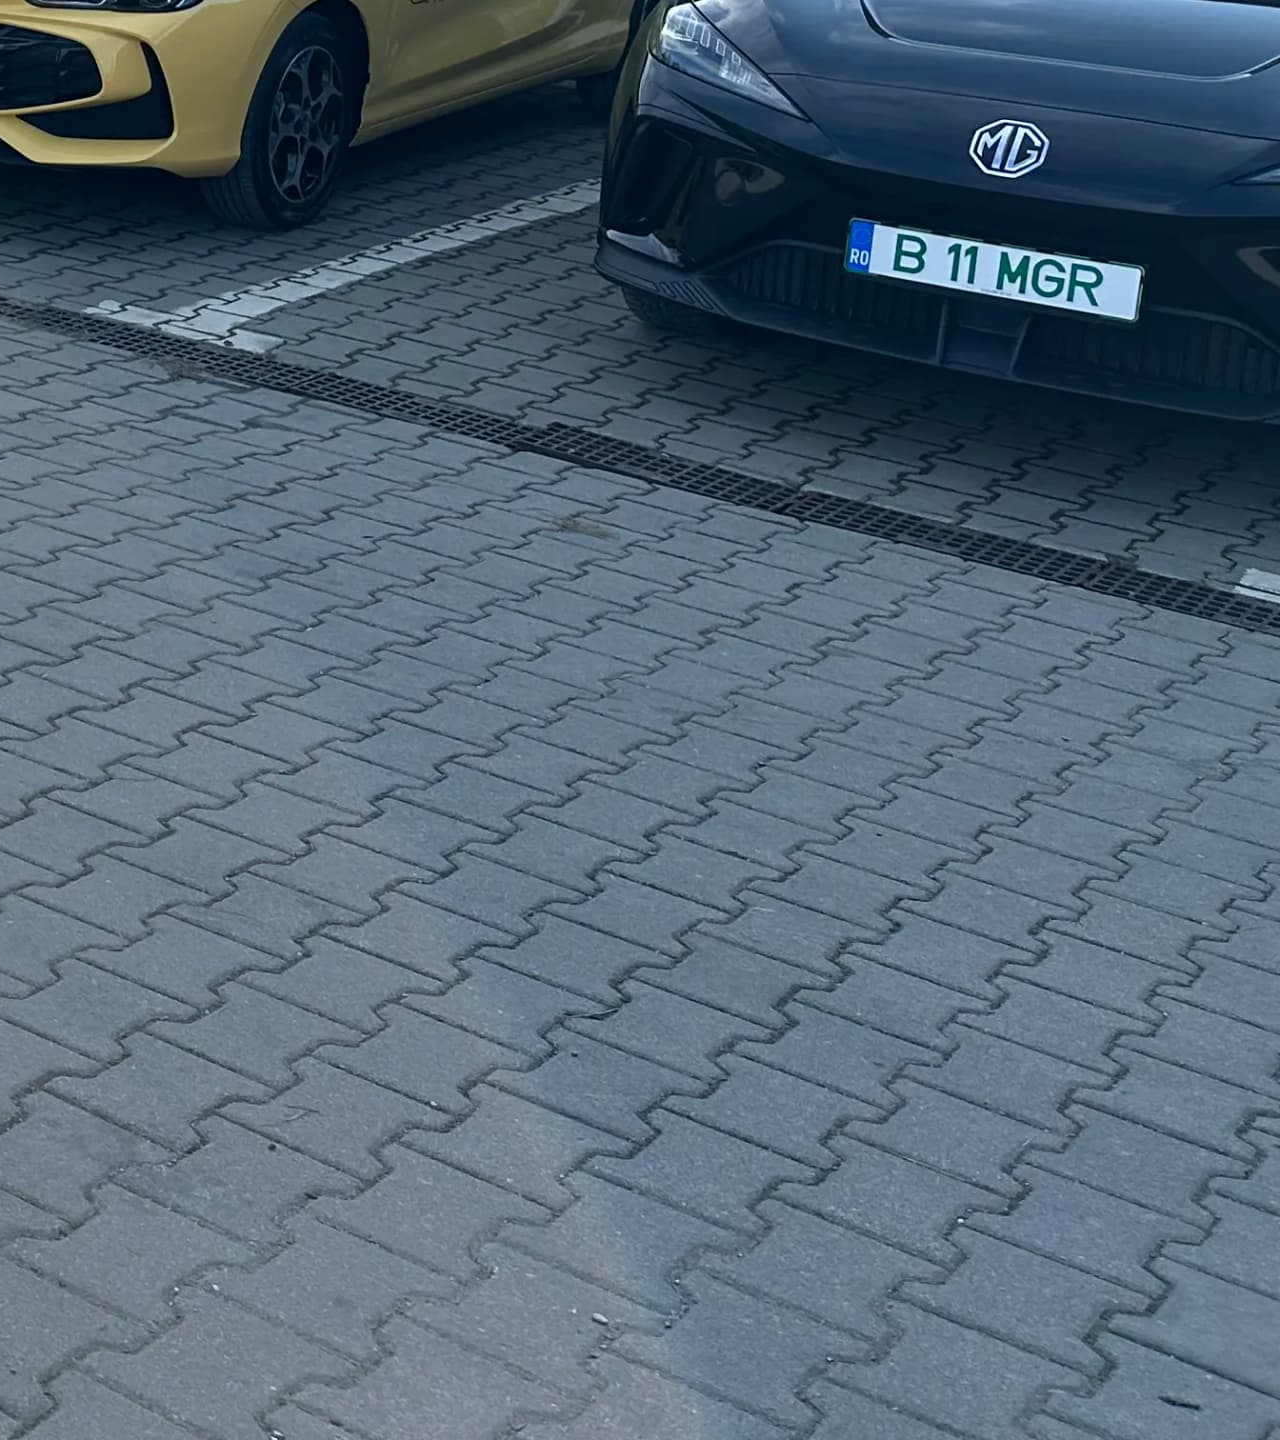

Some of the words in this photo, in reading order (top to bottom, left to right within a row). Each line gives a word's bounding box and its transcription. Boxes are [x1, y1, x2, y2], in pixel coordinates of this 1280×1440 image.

[976, 124, 1042, 172] MG
[849, 247, 869, 266] RO
[892, 232, 928, 274] B
[947, 243, 979, 285] 11
[995, 250, 1104, 307] MGR
